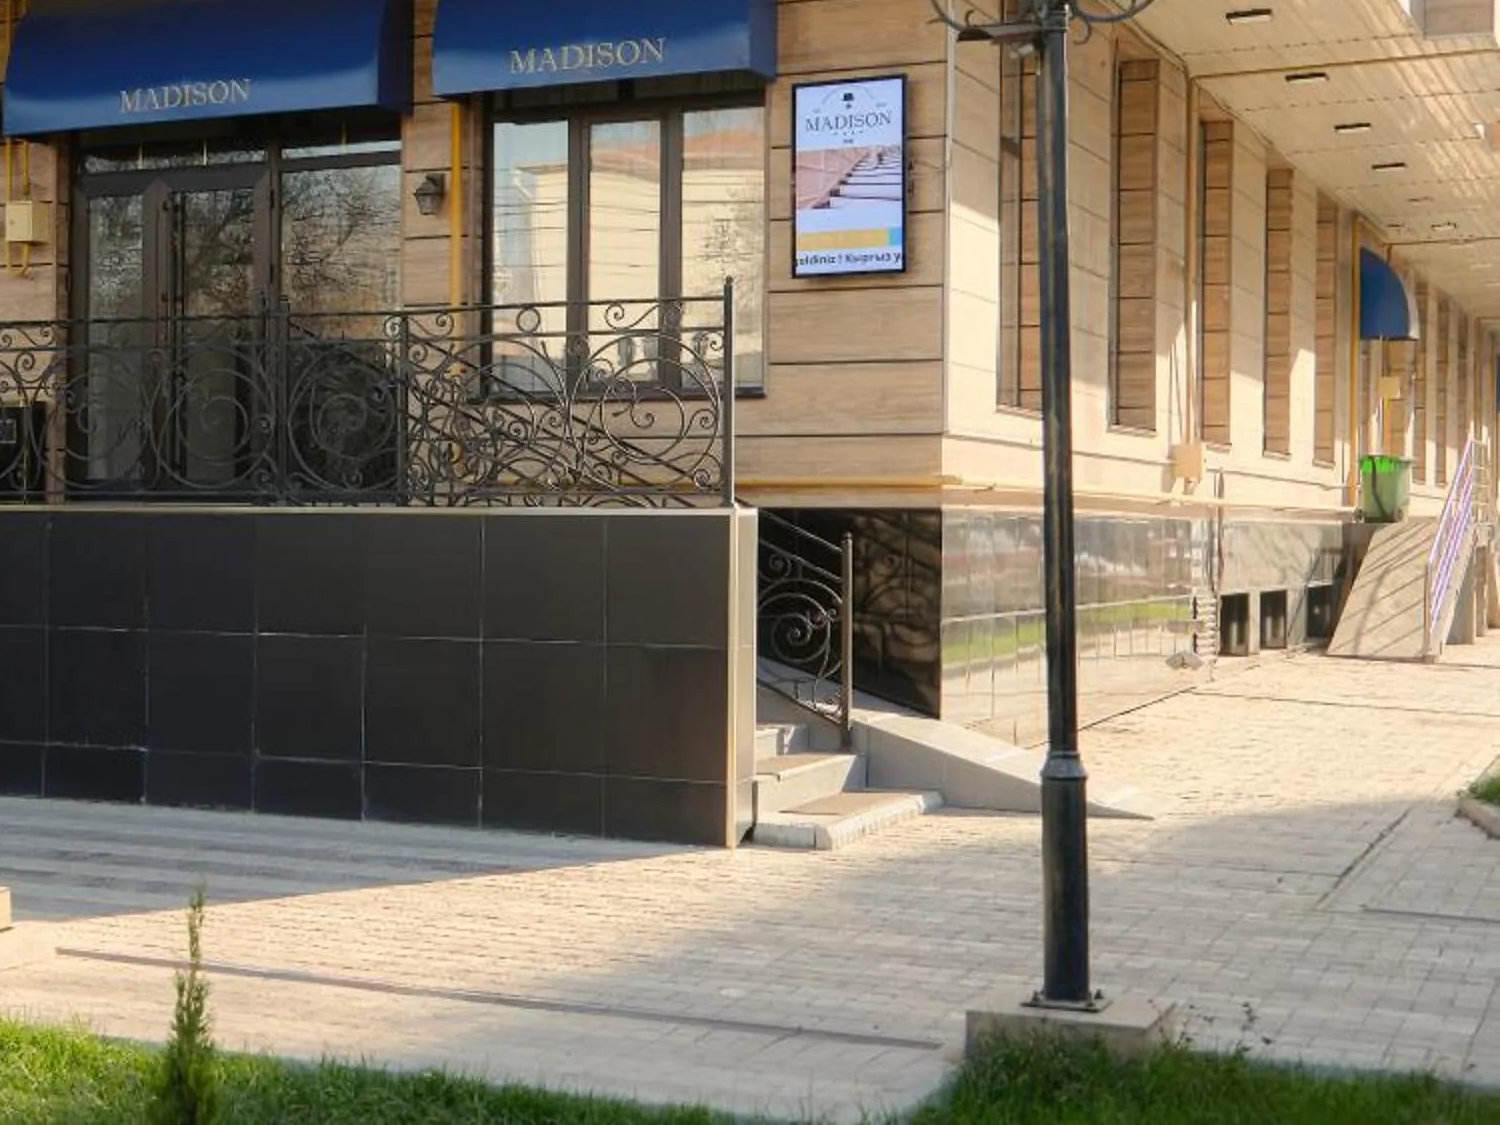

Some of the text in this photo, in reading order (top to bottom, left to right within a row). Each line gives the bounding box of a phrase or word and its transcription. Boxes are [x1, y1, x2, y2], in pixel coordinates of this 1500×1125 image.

[508, 37, 666, 74] MADISON
[120, 78, 251, 113] MADISON
[805, 111, 891, 131] MADISON
